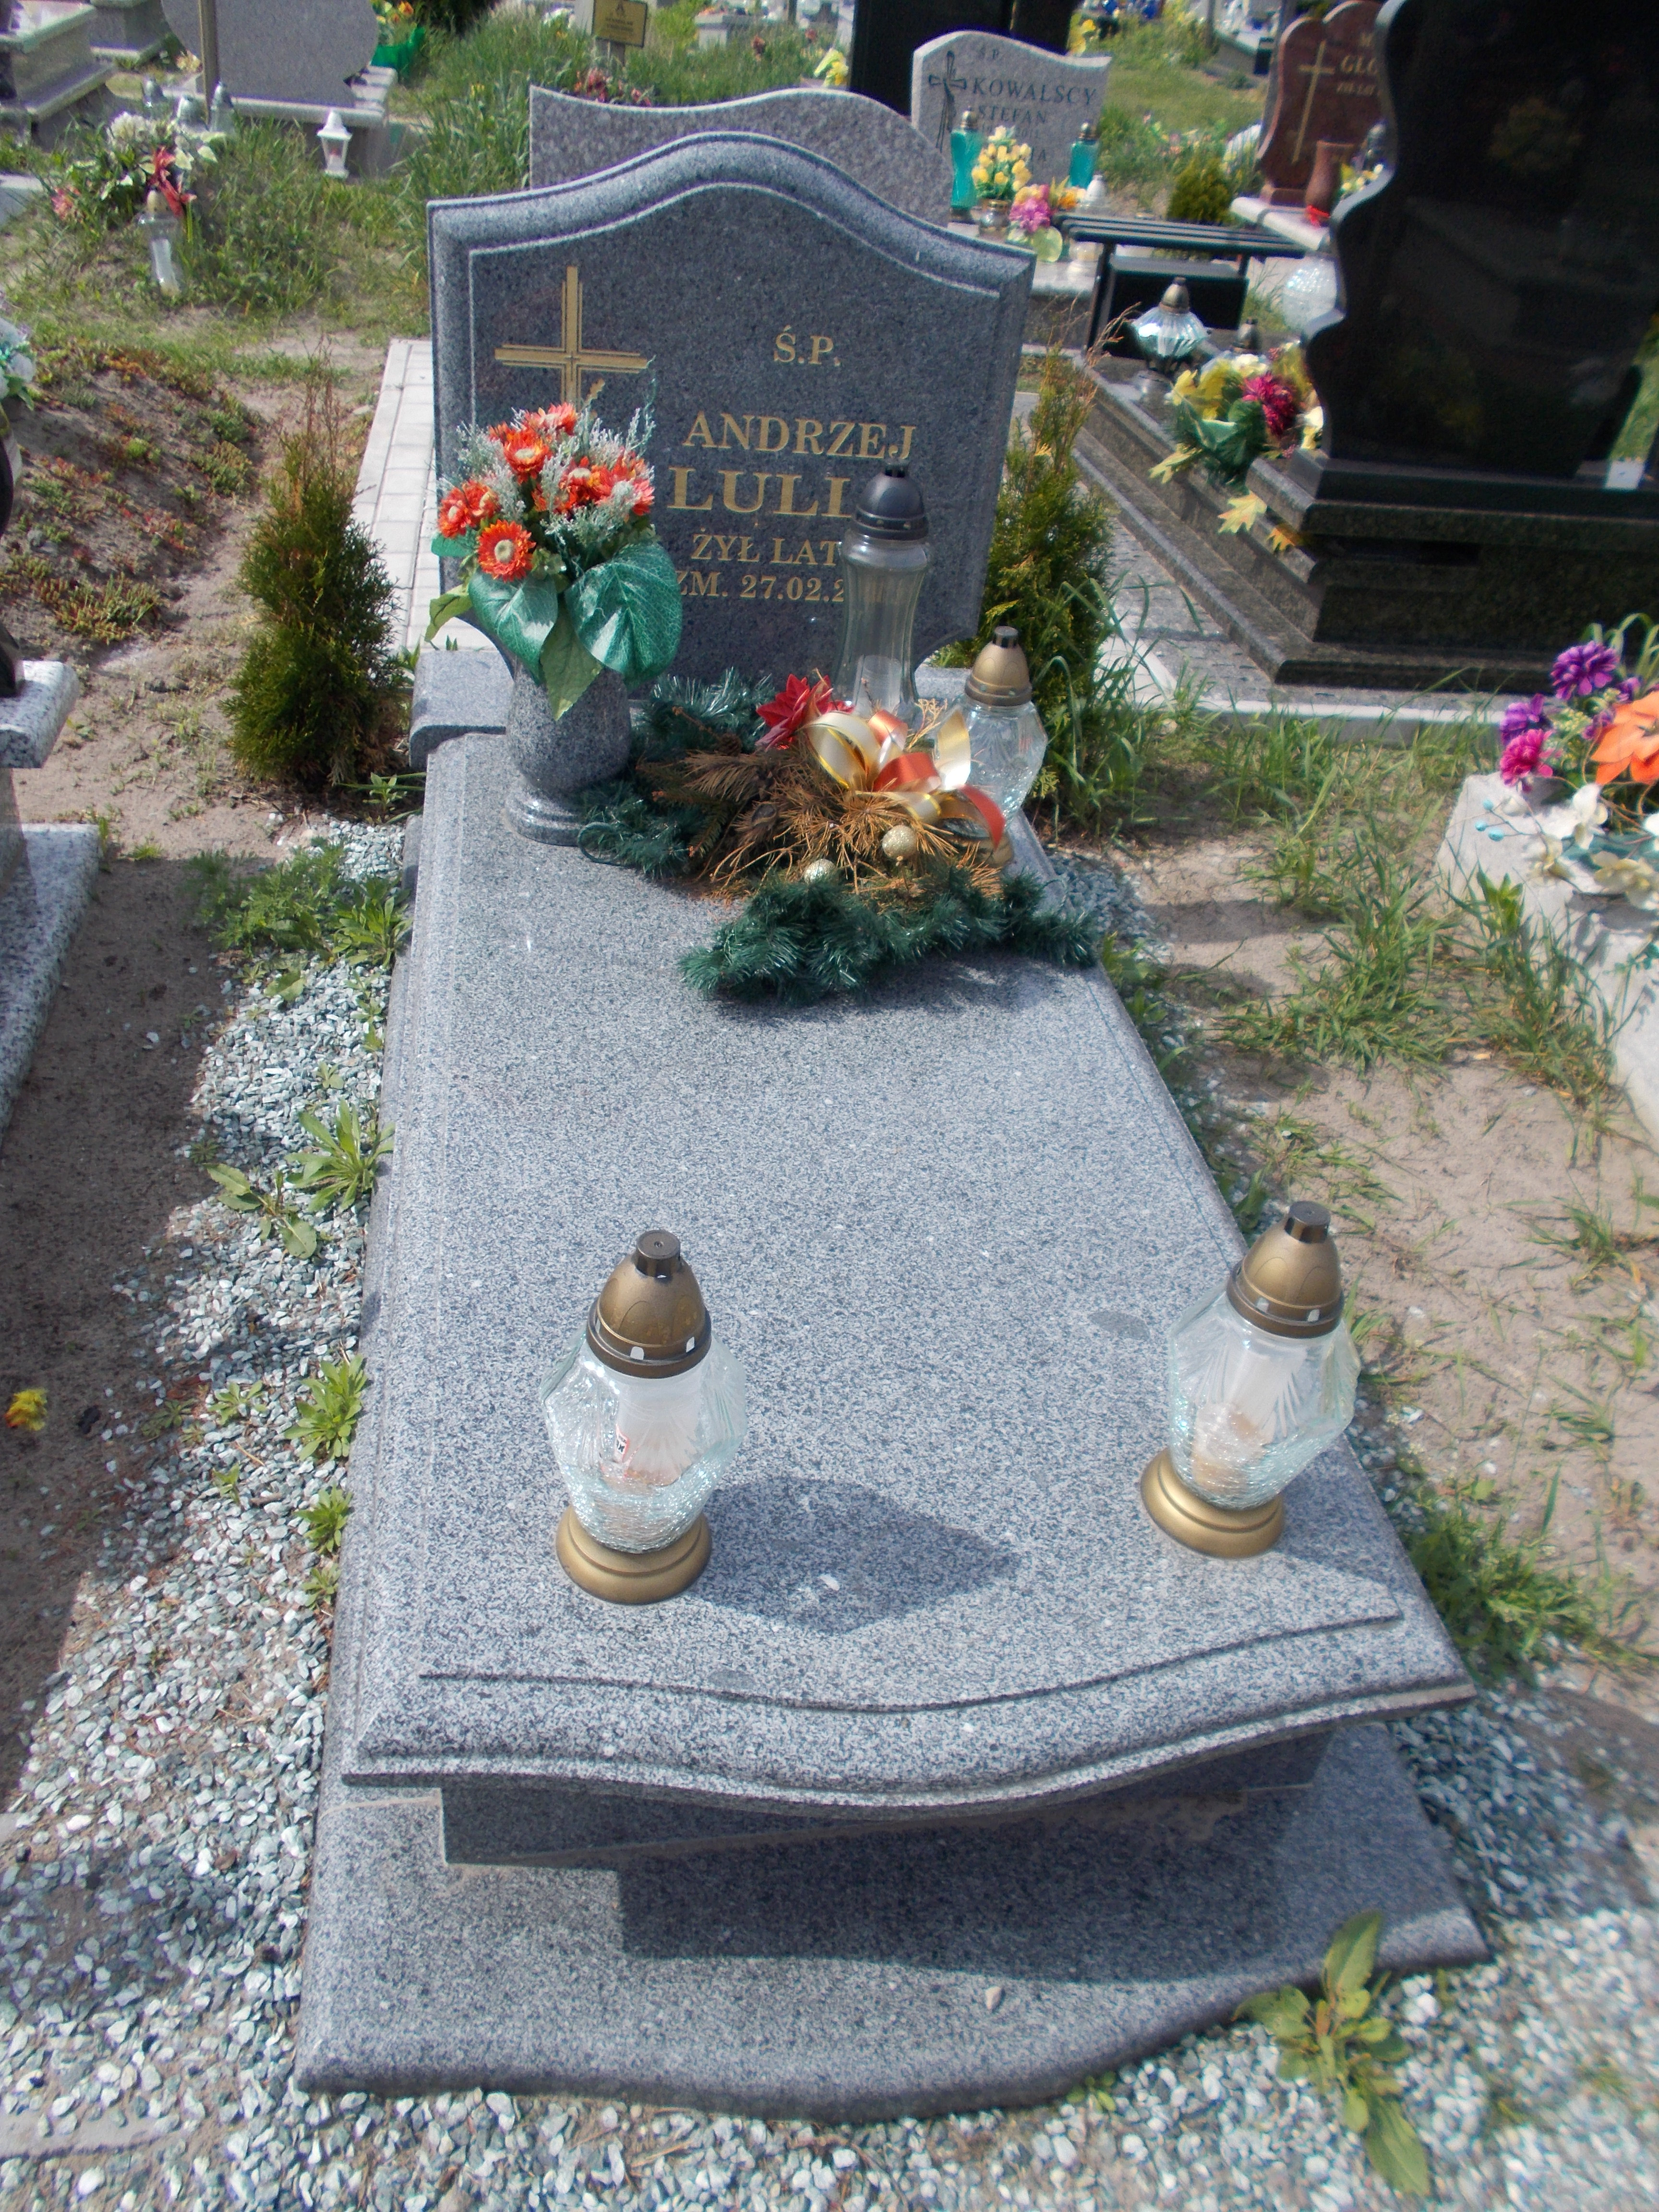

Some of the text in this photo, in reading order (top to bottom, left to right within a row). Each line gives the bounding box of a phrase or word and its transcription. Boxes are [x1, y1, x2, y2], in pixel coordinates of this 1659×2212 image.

[973, 77, 1096, 106] KOWALSCY
[978, 105, 1047, 124] STEFAN
[773, 325, 841, 366] Ś.P.
[682, 410, 916, 460] ANDRZEJ
[667, 465, 852, 518] LULI
[691, 527, 838, 566] ŻYŁ LAT
[740, 574, 844, 603] 27.02.2
